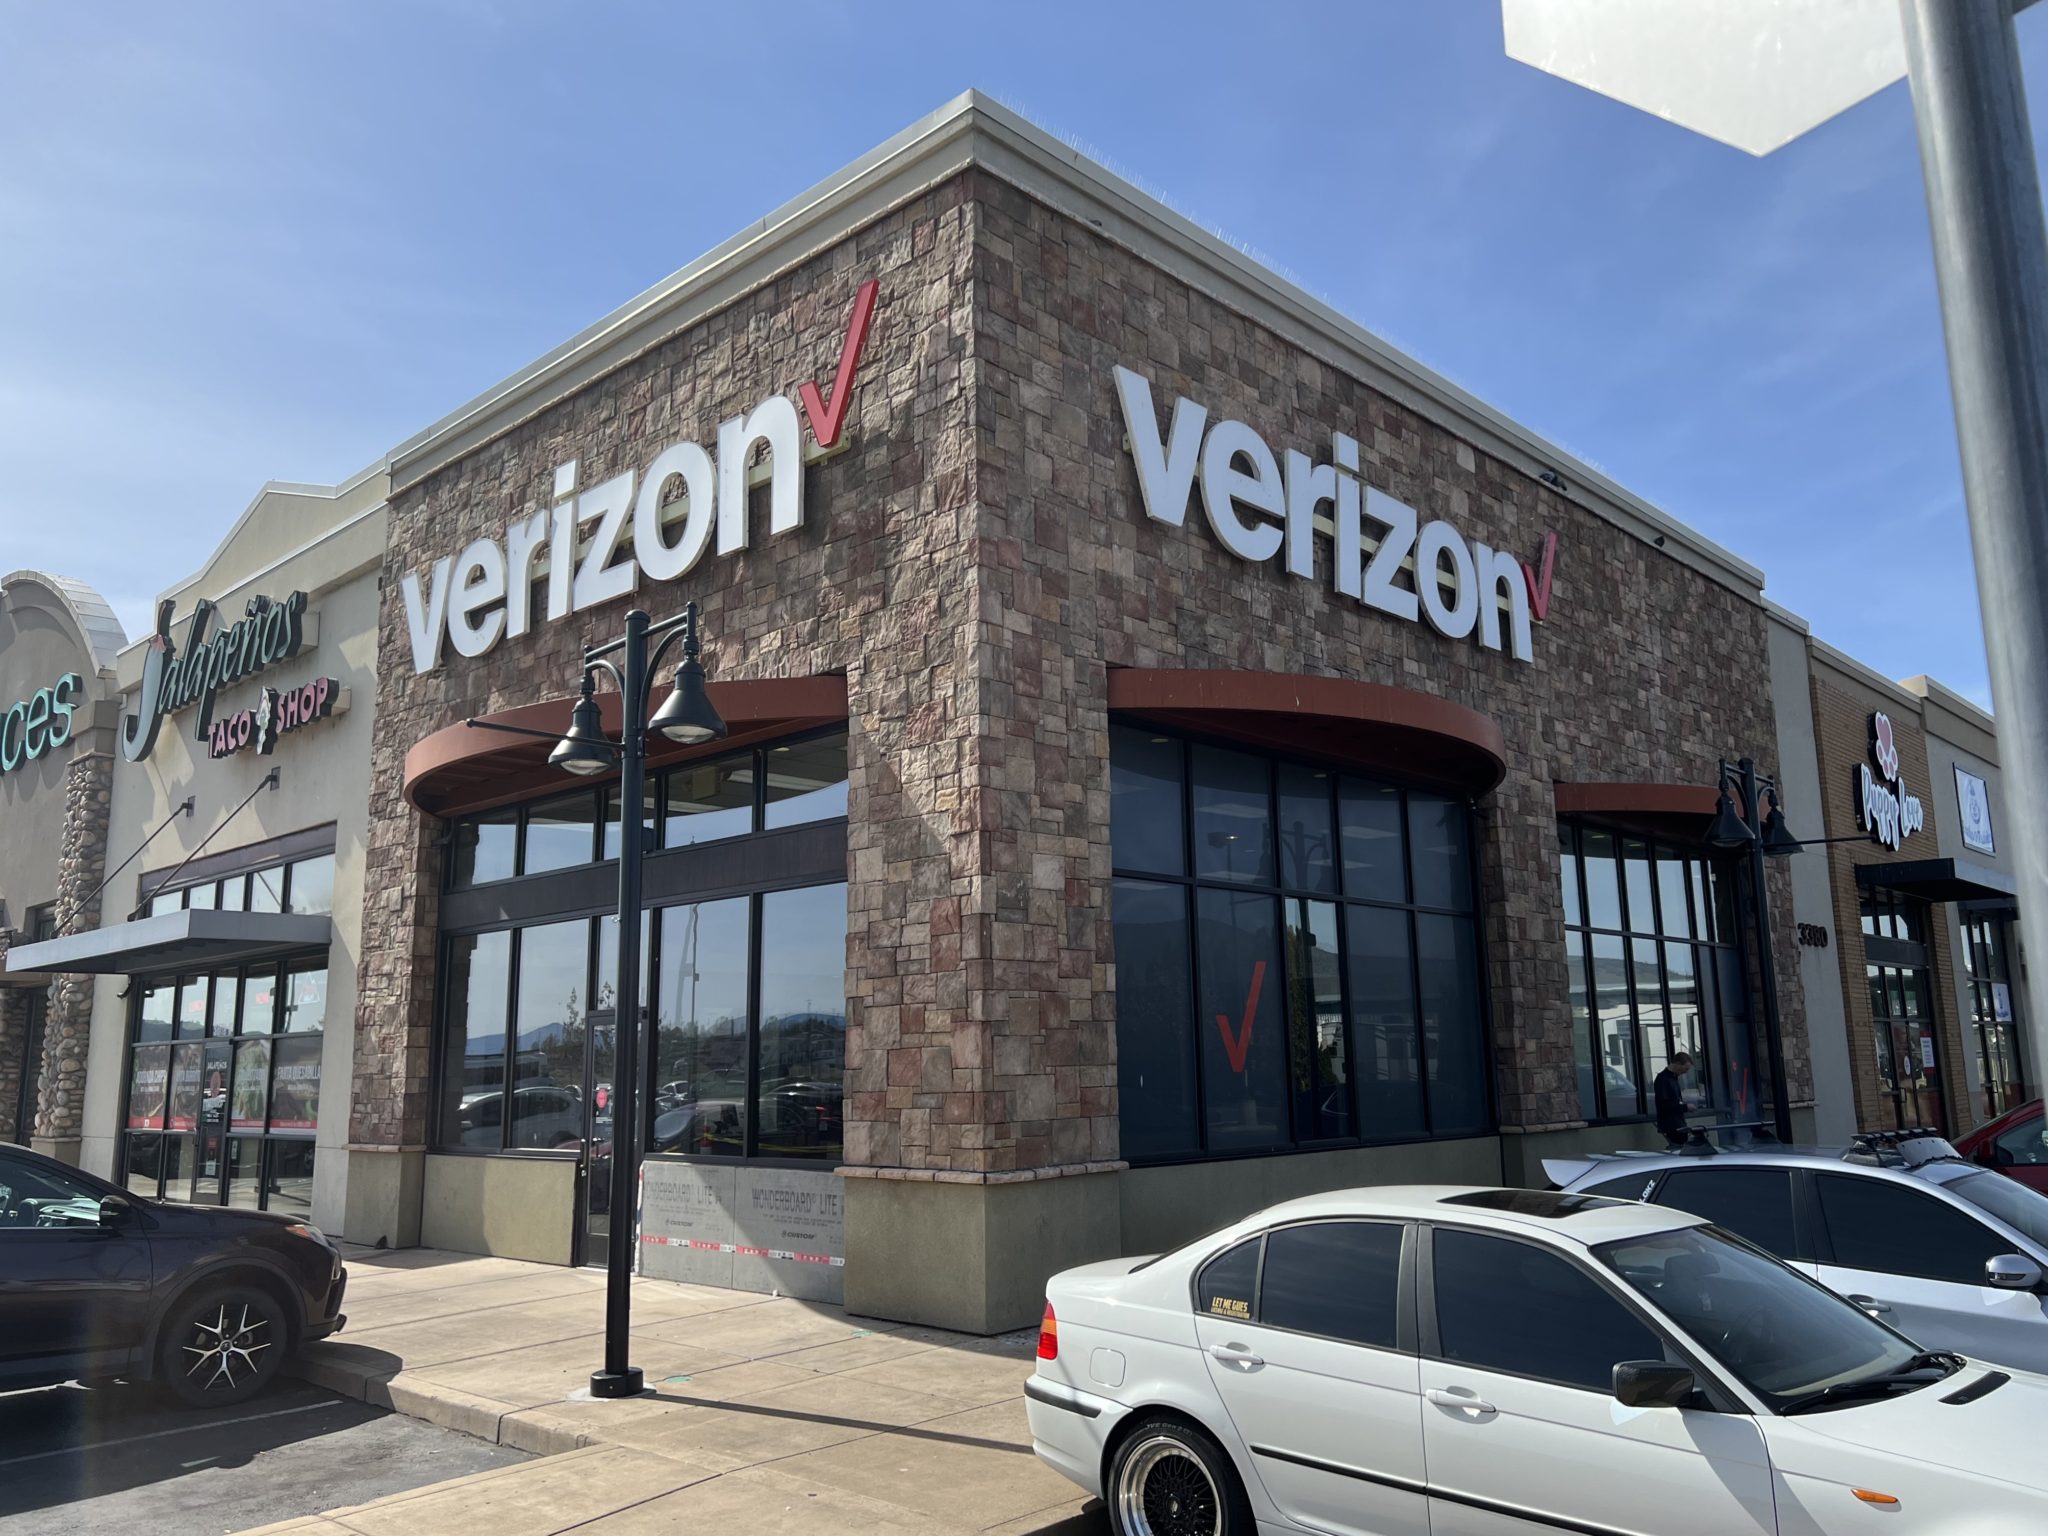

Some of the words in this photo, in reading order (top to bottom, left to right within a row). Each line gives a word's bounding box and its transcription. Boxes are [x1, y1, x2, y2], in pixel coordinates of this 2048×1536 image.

[402, 395, 804, 674] verizon
[1112, 364, 1533, 663] verizon
[122, 591, 306, 762] Jalapeños
[208, 709, 252, 758] TACO
[275, 677, 331, 734] SHOP
[1861, 763, 1899, 852] Puppy
[1898, 776, 1924, 838] Love
[1797, 922, 1829, 948] 3380
[819, 1192, 838, 1216] LITE
[1212, 1296, 1223, 1308] LET
[1222, 1298, 1233, 1309] ME
